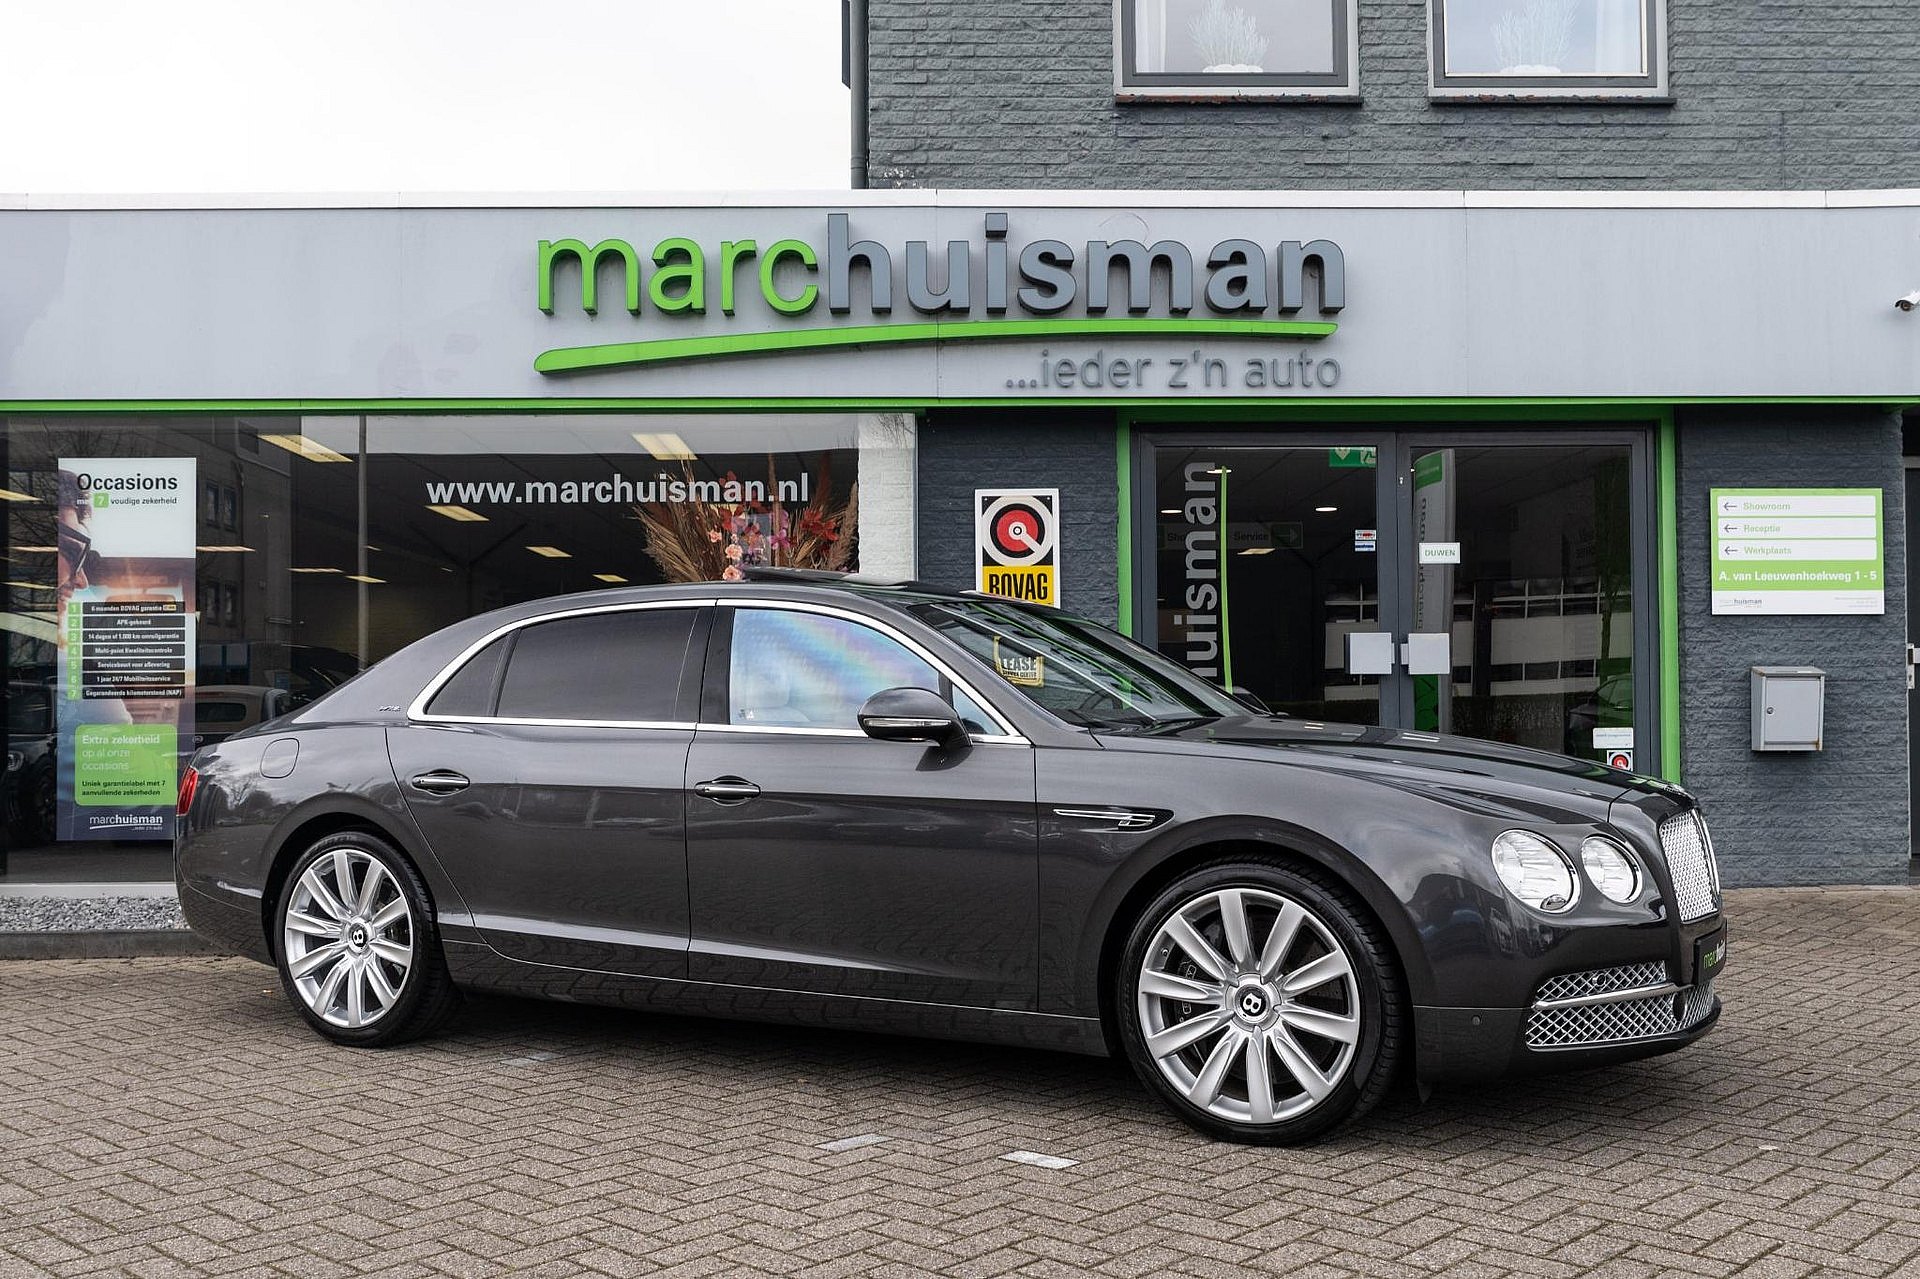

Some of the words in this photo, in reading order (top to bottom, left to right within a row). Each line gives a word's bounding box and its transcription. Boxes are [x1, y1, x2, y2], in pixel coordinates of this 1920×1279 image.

[538, 213, 1345, 316] marchuisman
[1005, 350, 1152, 389] ...ieder
[1168, 350, 1228, 389] z'n
[1246, 350, 1342, 389] auto
[77, 473, 178, 490] Occasions
[425, 472, 809, 504] www.marchuisman.nl
[98, 496, 105, 504] 7
[111, 497, 140, 506] voudige
[142, 497, 177, 505] zekerheid
[1743, 502, 1791, 511] Showroom
[1743, 524, 1781, 534] Receptie
[1424, 549, 1456, 557] DUWEN
[1744, 546, 1792, 556] Werkplaats
[1718, 571, 1730, 581] A.
[1733, 572, 1752, 581] van
[1754, 570, 1852, 583] Leeuwenhoekweg
[1855, 571, 1860, 581] 1
[1870, 571, 1877, 581] 5
[988, 573, 1048, 600] BOVAG
[82, 735, 109, 744] Extra
[111, 734, 160, 745] zekerheid
[82, 750, 94, 760] op
[106, 749, 130, 758] onze
[82, 761, 129, 770] occasions
[102, 780, 146, 788] garantielabel
[89, 814, 163, 824] marchuisman
